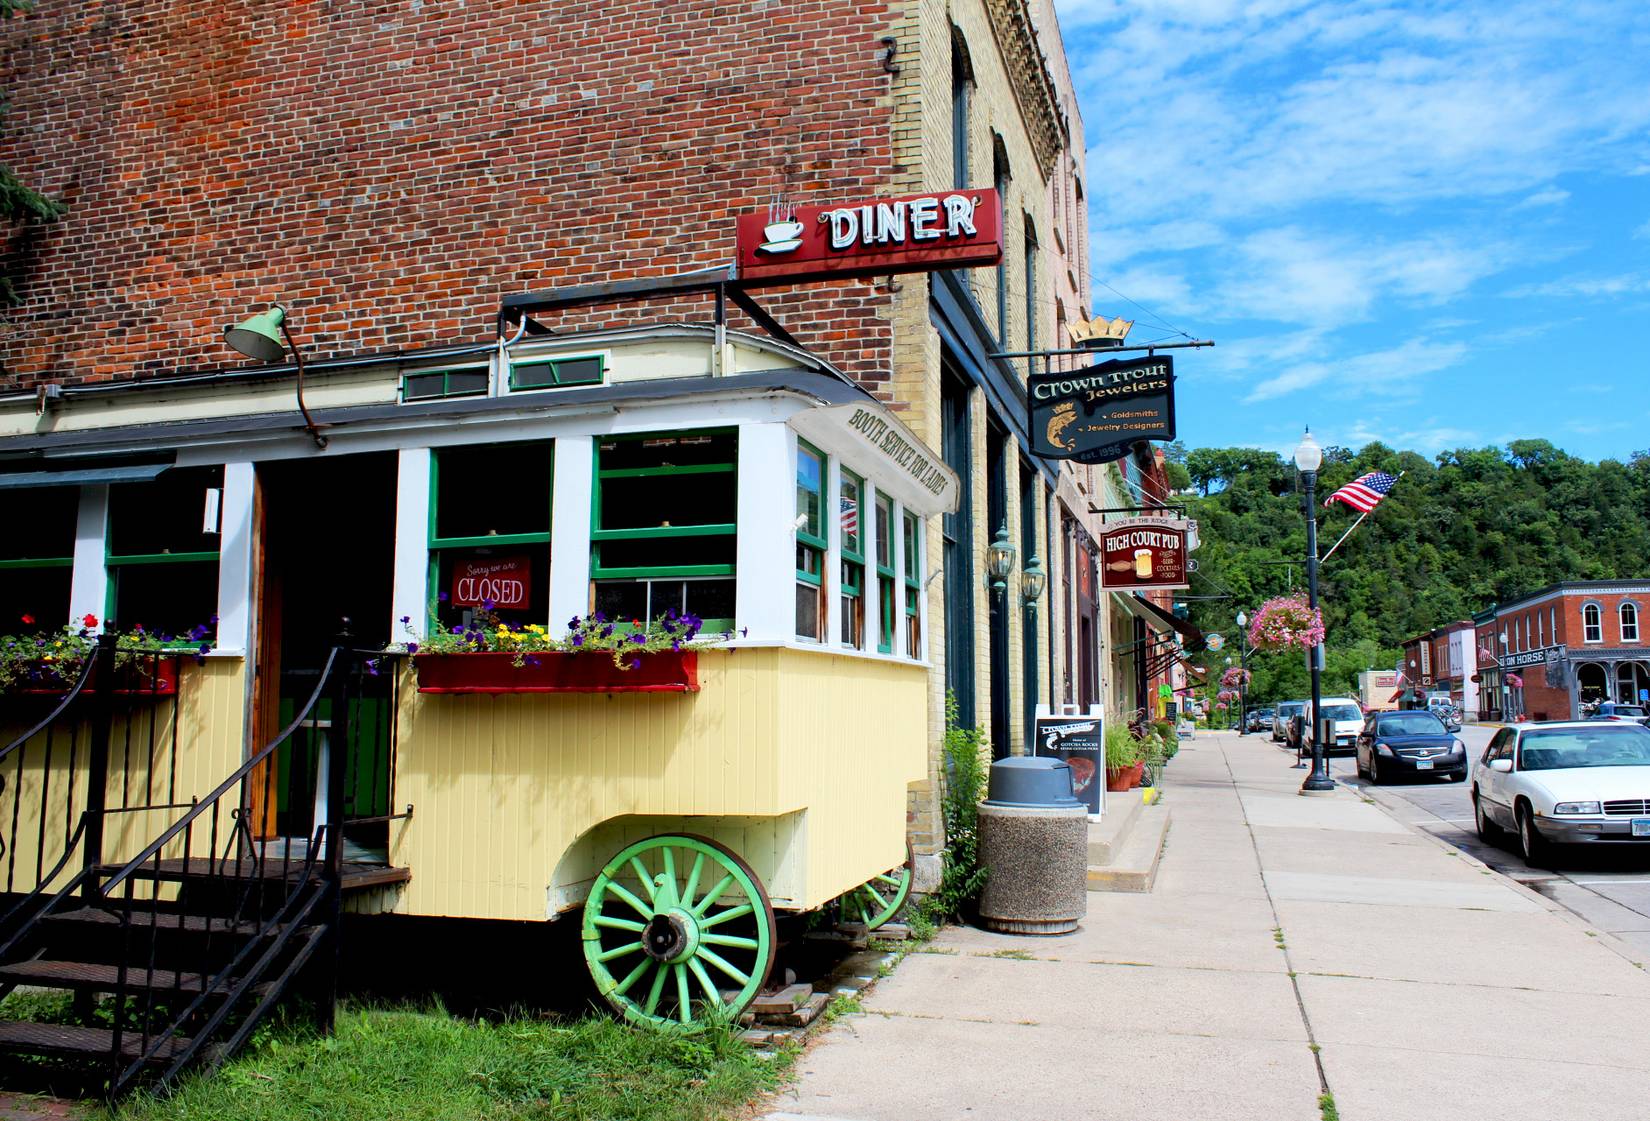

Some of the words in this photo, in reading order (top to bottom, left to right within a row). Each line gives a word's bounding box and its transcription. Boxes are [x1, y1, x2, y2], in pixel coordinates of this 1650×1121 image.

[832, 194, 976, 248] DINER
[1034, 376, 1103, 400] Crown
[1107, 364, 1167, 384] Trout
[1086, 379, 1167, 401] Jewelers
[1111, 410, 1159, 419] Goldsmiths
[1087, 424, 1121, 432] Jewelry
[1122, 421, 1165, 431] Designers
[848, 409, 888, 444] BOOTH
[880, 430, 916, 467] SERVICE
[907, 454, 929, 477] FOR
[920, 465, 948, 495] LADIES
[1106, 534, 1129, 552] HIGH
[1131, 531, 1161, 547] COURT
[1162, 534, 1180, 550] PUB
[467, 563, 490, 577] Sorry
[458, 578, 523, 603] CLOSED
[1517, 651, 1544, 664] HORSE
